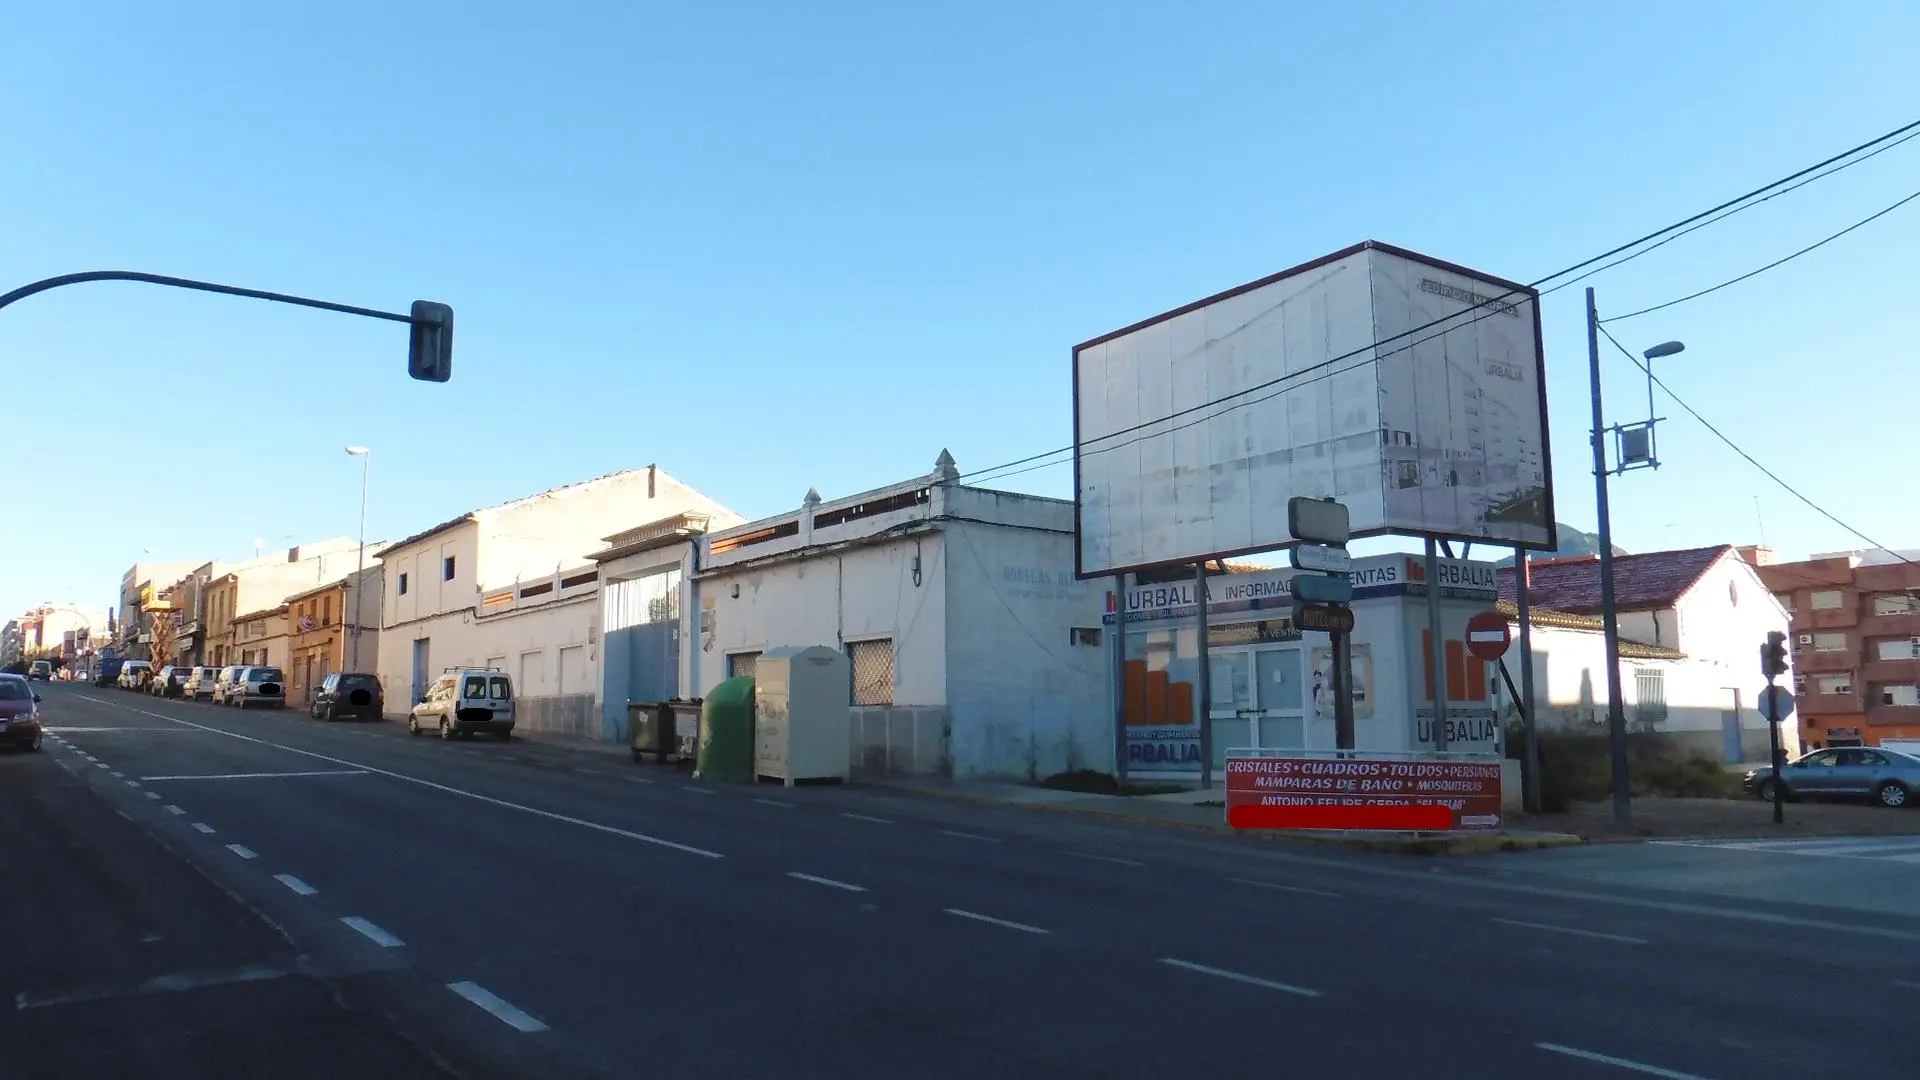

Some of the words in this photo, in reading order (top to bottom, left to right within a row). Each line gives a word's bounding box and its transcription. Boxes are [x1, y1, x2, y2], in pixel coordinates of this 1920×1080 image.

[1225, 579, 1292, 600] INFORMAC
[1348, 567, 1395, 585] ENTAS
[1439, 564, 1495, 587] RBALIA
[1417, 719, 1495, 743] UBALIA
[1130, 743, 1200, 764] RBALIA
[1228, 761, 1292, 773] CRISTALES
[1302, 762, 1379, 775] CUADROS
[1390, 764, 1443, 777] TOLDOS
[1449, 766, 1499, 778] PERSIANAS
[1255, 777, 1331, 789] MAMPARAS
[1336, 779, 1357, 790] DE
[1360, 778, 1403, 791] BAÑO
[1416, 780, 1482, 791] MOSQUITERAS
[1261, 796, 1314, 806] ANTONIO
